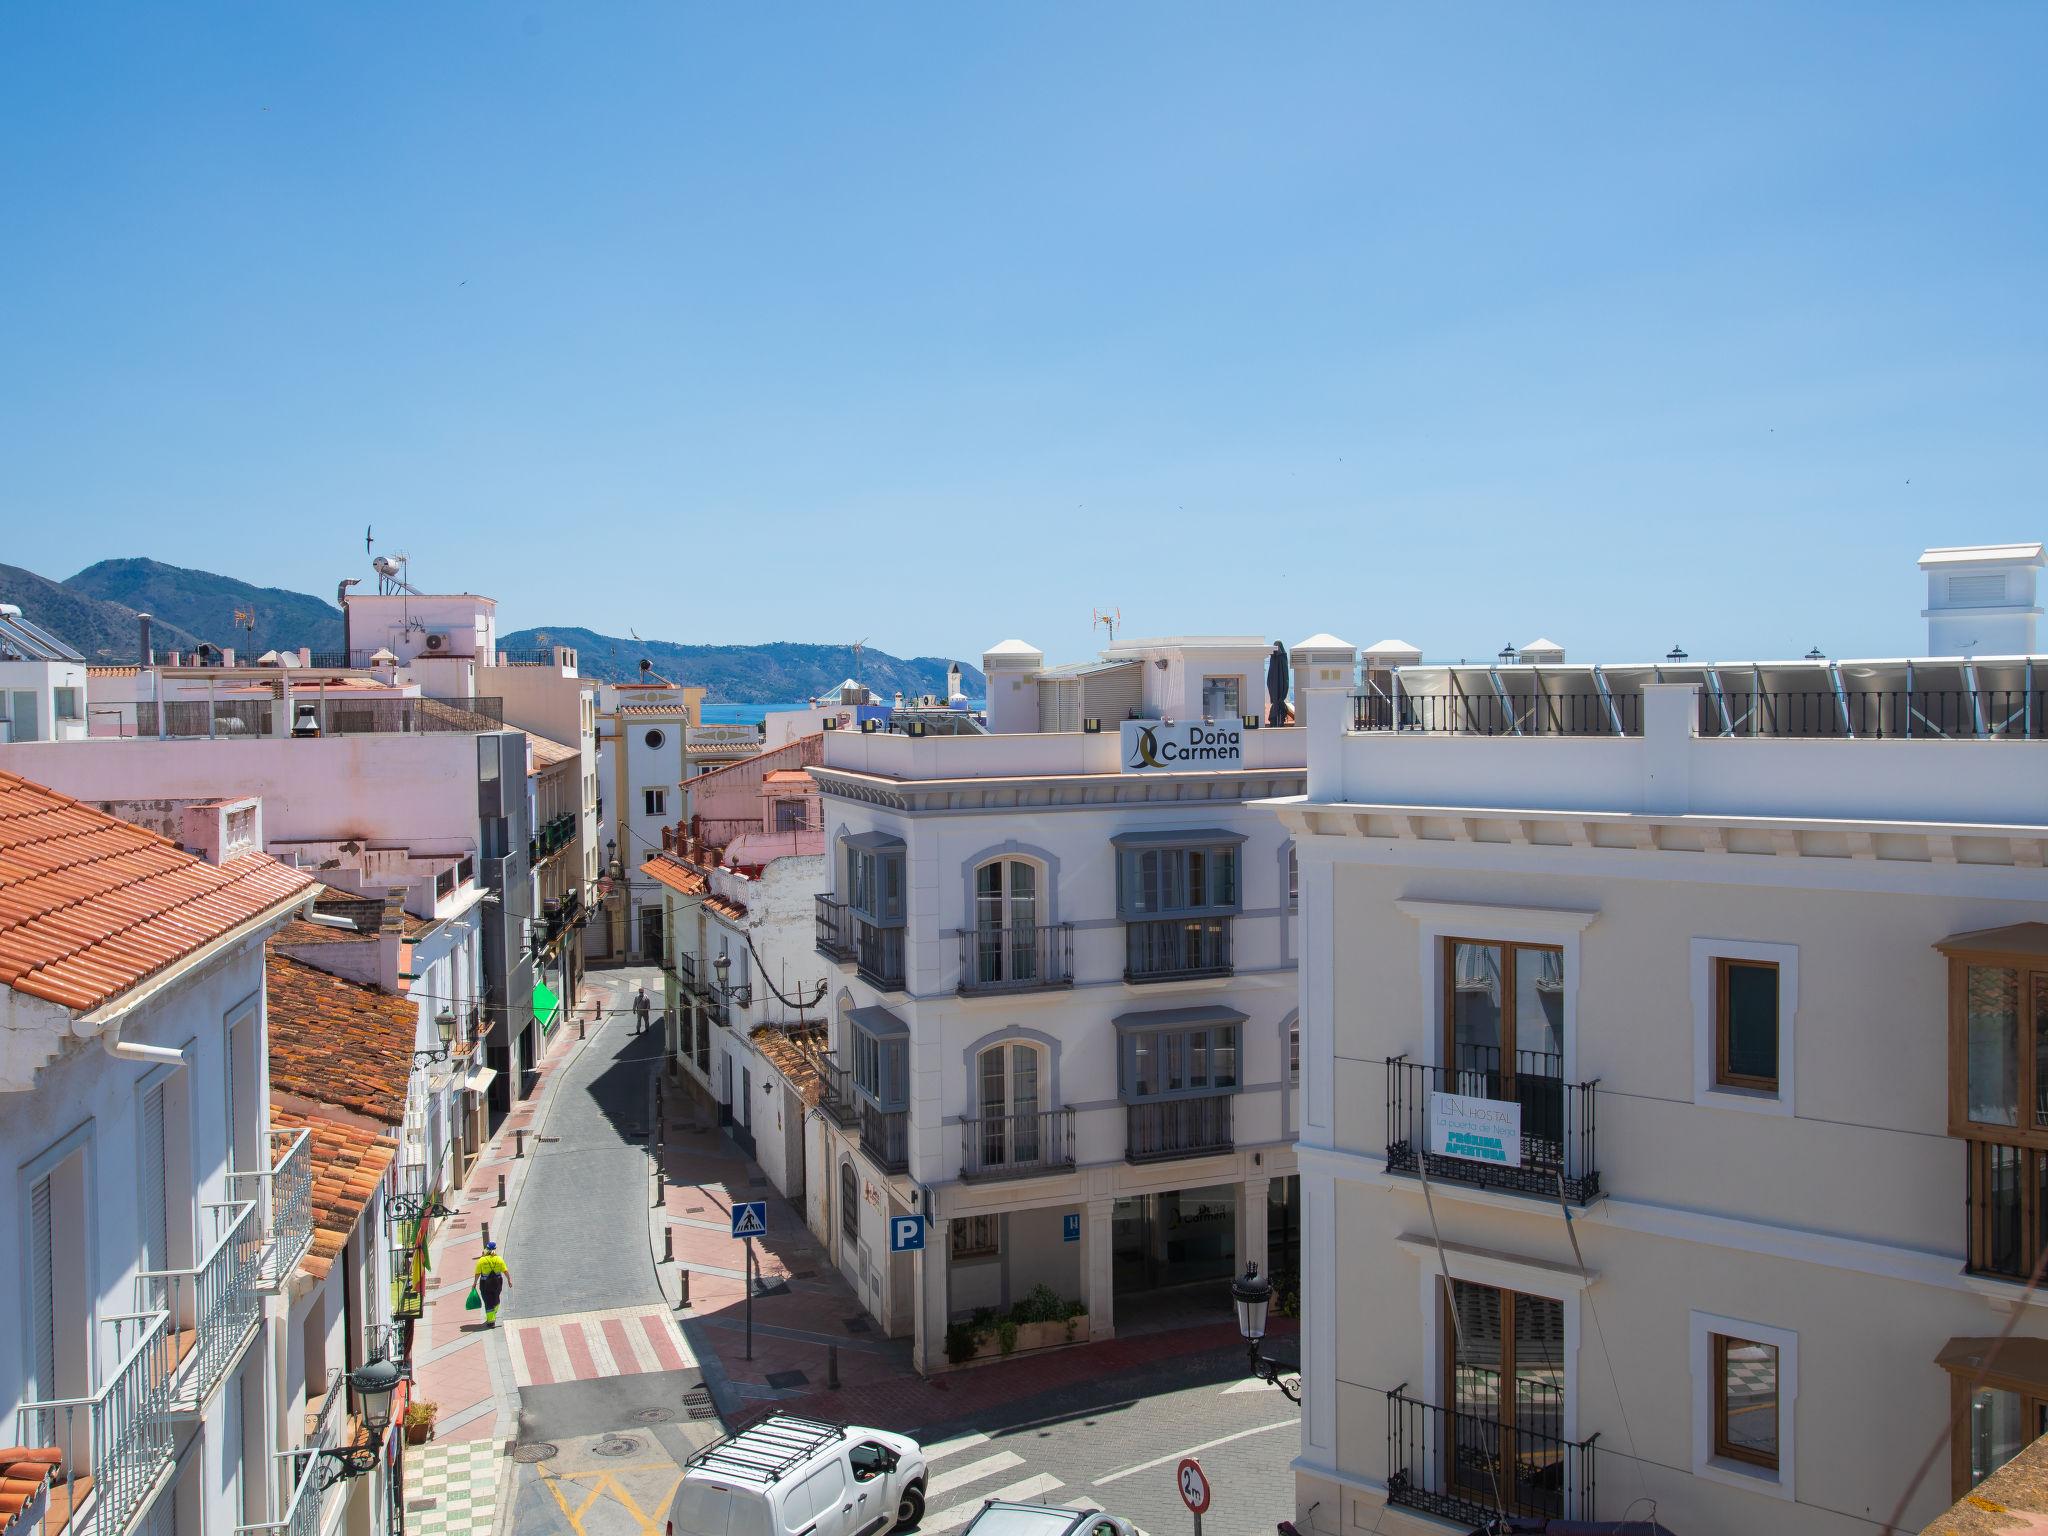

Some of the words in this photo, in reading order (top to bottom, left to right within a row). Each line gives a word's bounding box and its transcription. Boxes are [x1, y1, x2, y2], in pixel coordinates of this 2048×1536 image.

[1190, 727, 1239, 745] Doña
[1161, 742, 1239, 760] Carmen
[1469, 1107, 1512, 1124] HOSTAL
[1447, 1131, 1503, 1149] PRÓXIMA
[1445, 1142, 1507, 1161] APERTURA
[897, 1220, 918, 1248] P
